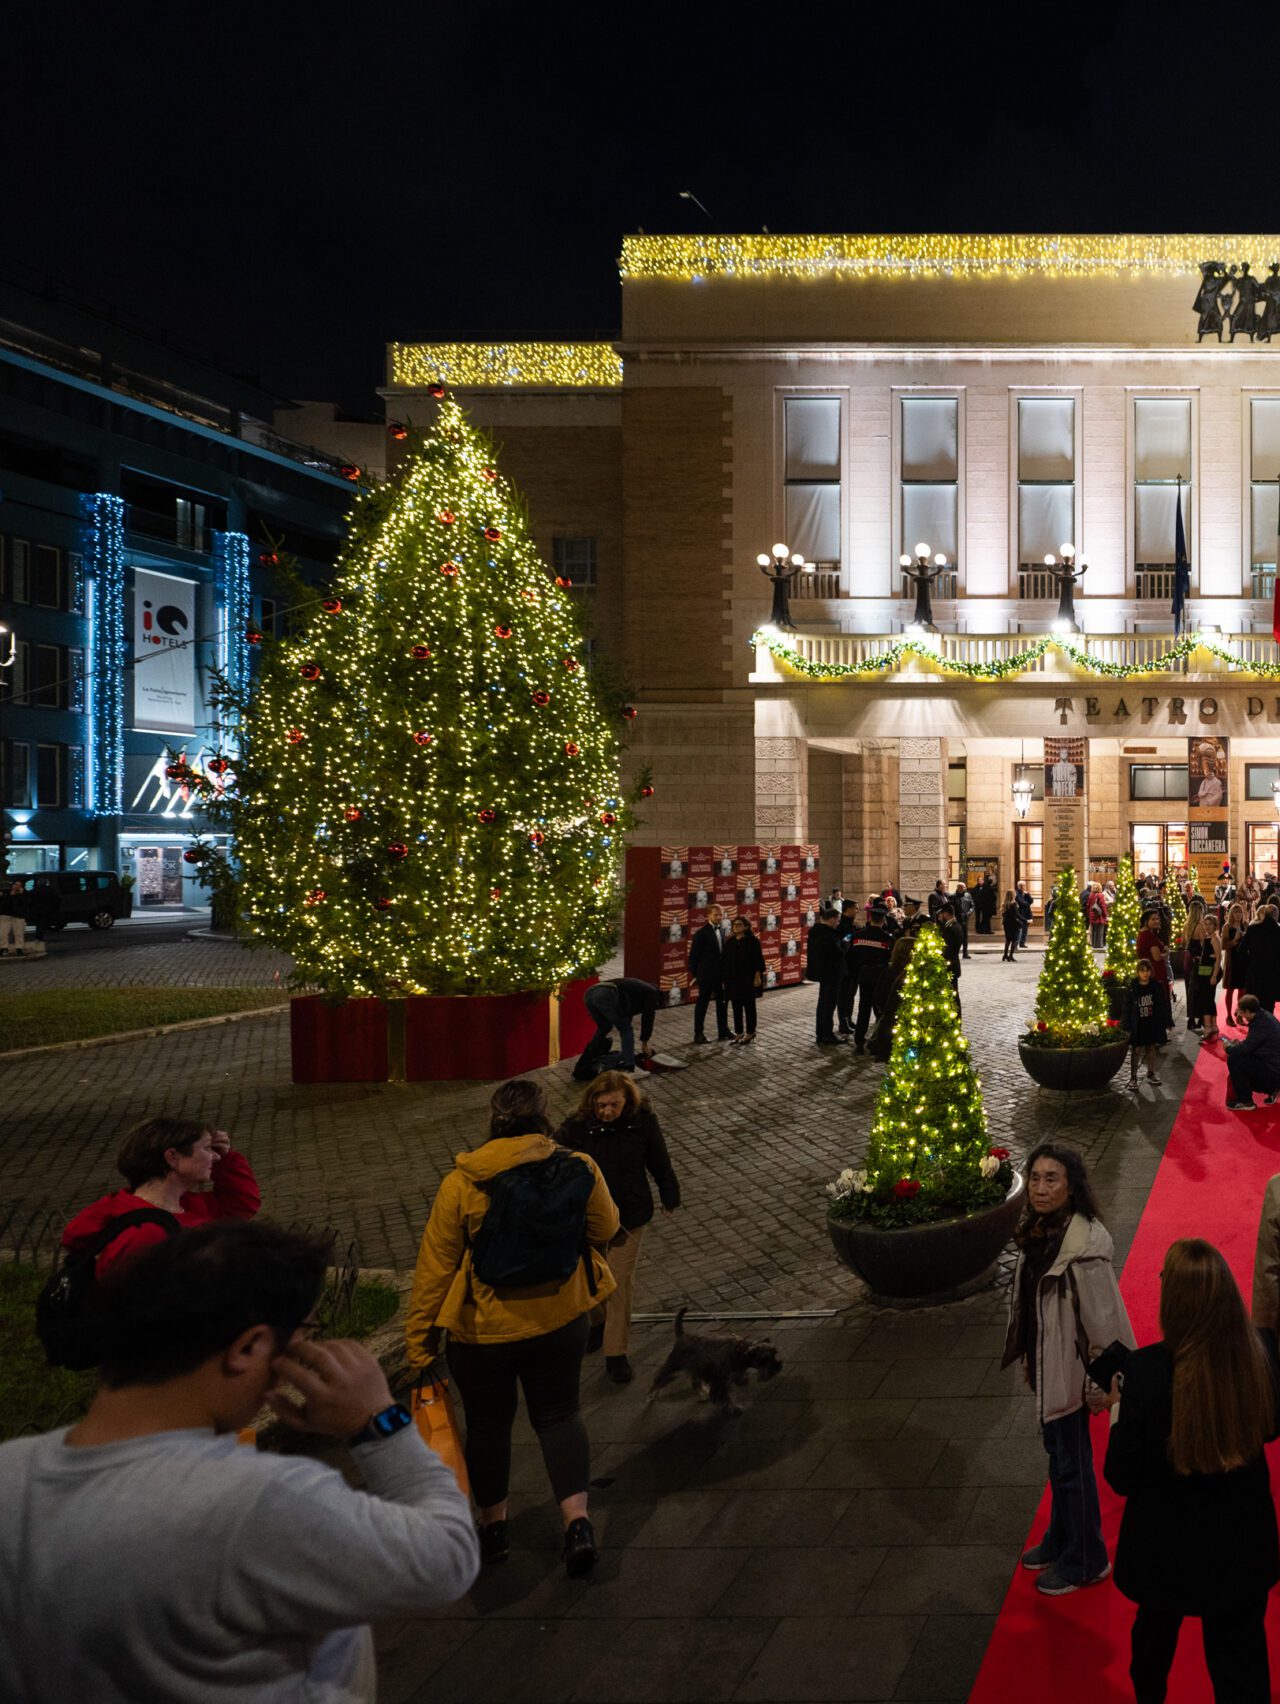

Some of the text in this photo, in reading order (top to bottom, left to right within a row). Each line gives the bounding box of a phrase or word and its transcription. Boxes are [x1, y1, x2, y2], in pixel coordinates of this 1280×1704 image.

[142, 633, 188, 650] HOTELS
[1054, 697, 1219, 717] TEATRO
[1191, 827, 1208, 839] SIMON
[1138, 994, 1153, 1007] LOOK
